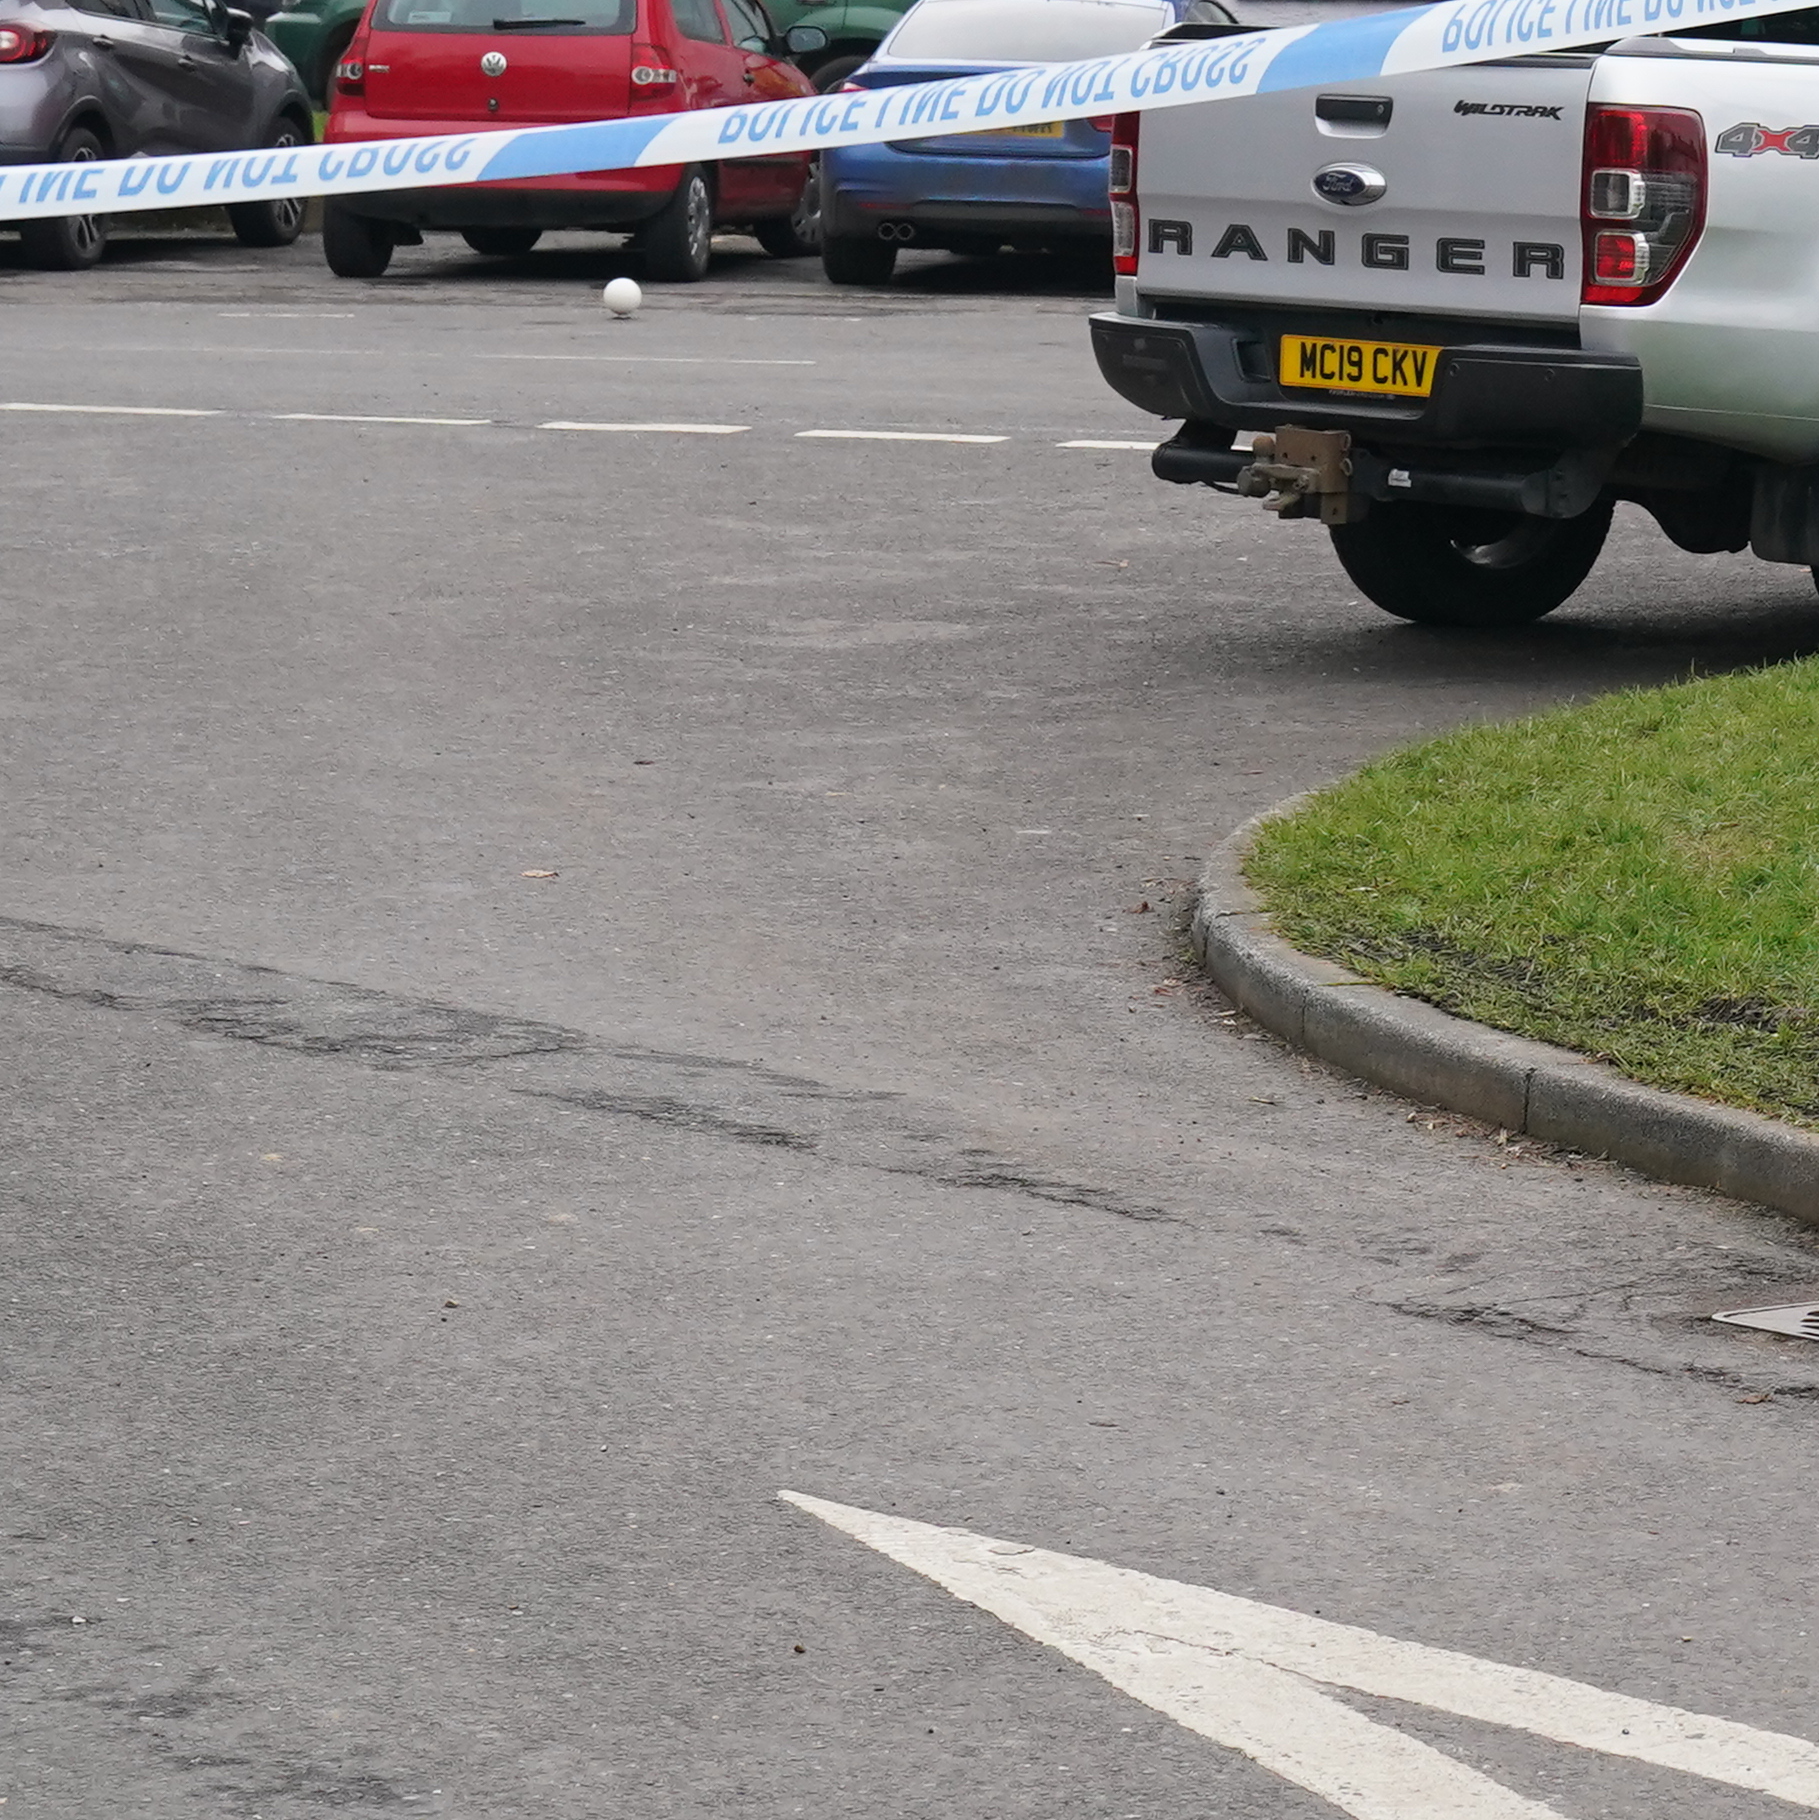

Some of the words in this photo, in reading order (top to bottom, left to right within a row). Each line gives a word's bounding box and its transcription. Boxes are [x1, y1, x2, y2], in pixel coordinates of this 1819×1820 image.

[1453, 99, 1564, 121] WILDTRAK
[1322, 173, 1357, 193] Ford
[1147, 217, 1565, 280] RANGER
[1299, 341, 1363, 383] MC19
[1372, 346, 1428, 388] CKV
